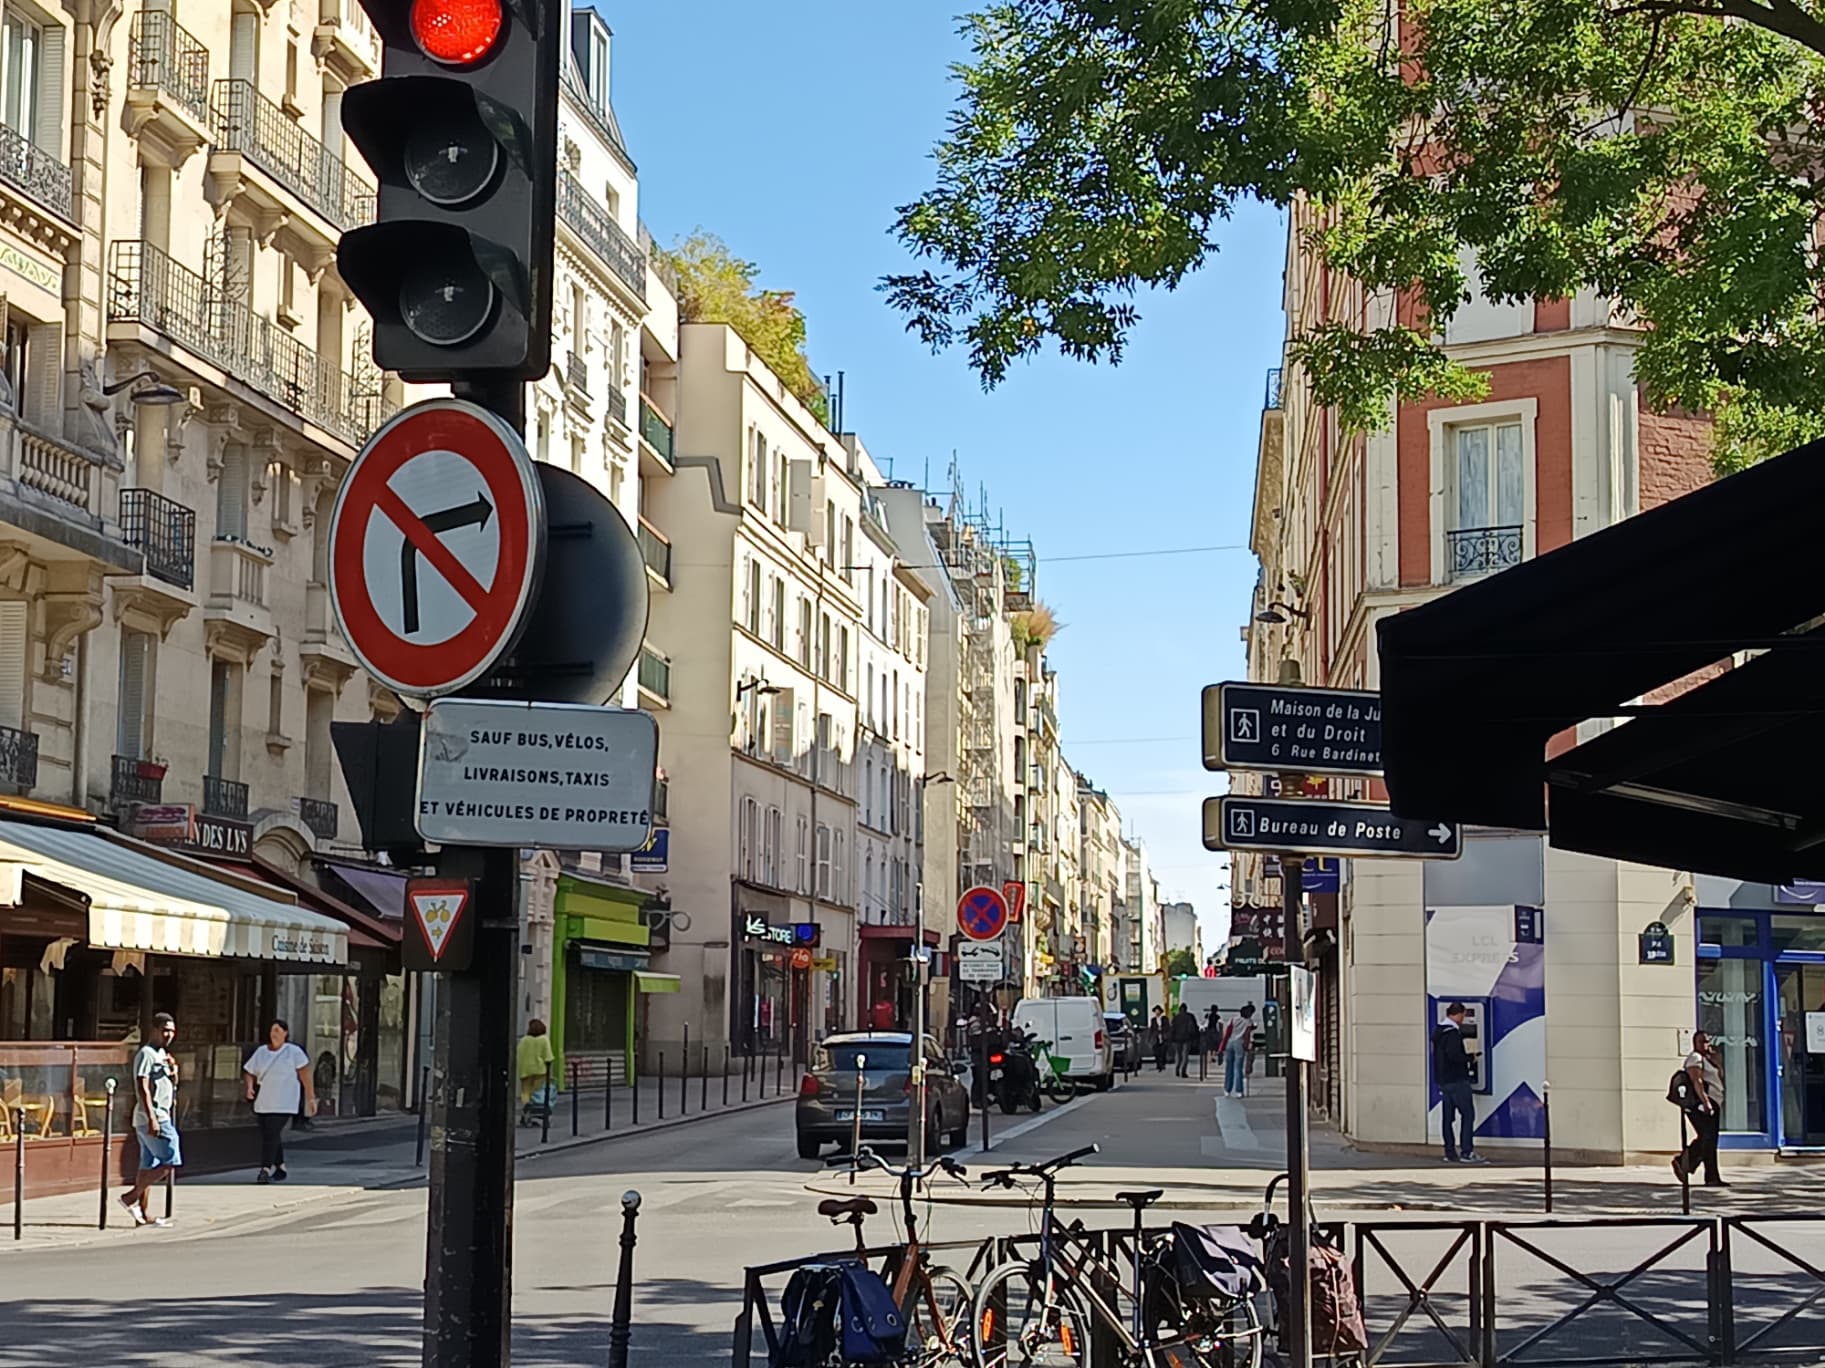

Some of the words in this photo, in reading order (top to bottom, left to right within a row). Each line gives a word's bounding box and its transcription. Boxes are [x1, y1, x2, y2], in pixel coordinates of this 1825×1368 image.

[1270, 699, 1322, 718] Maison
[1326, 703, 1342, 719] de
[1347, 704, 1360, 720] la
[470, 730, 512, 746] SAUF
[1271, 724, 1287, 738] et
[1297, 724, 1315, 739] du
[1324, 725, 1366, 742] Droit
[1271, 743, 1280, 756] 6
[1291, 745, 1316, 759] Rue
[1323, 747, 1381, 764] Bardinet
[566, 771, 610, 787] TAXIS
[420, 800, 439, 815] ET
[445, 800, 534, 820] VÉHICULES
[540, 806, 559, 821] DE
[565, 807, 650, 827] PROPRETÉ
[202, 822, 224, 850] DES
[226, 827, 248, 854] LYS
[1259, 816, 1319, 836] Bureau
[1327, 820, 1347, 837] de
[1355, 821, 1401, 840] Poste
[1471, 935, 1499, 947] LCL
